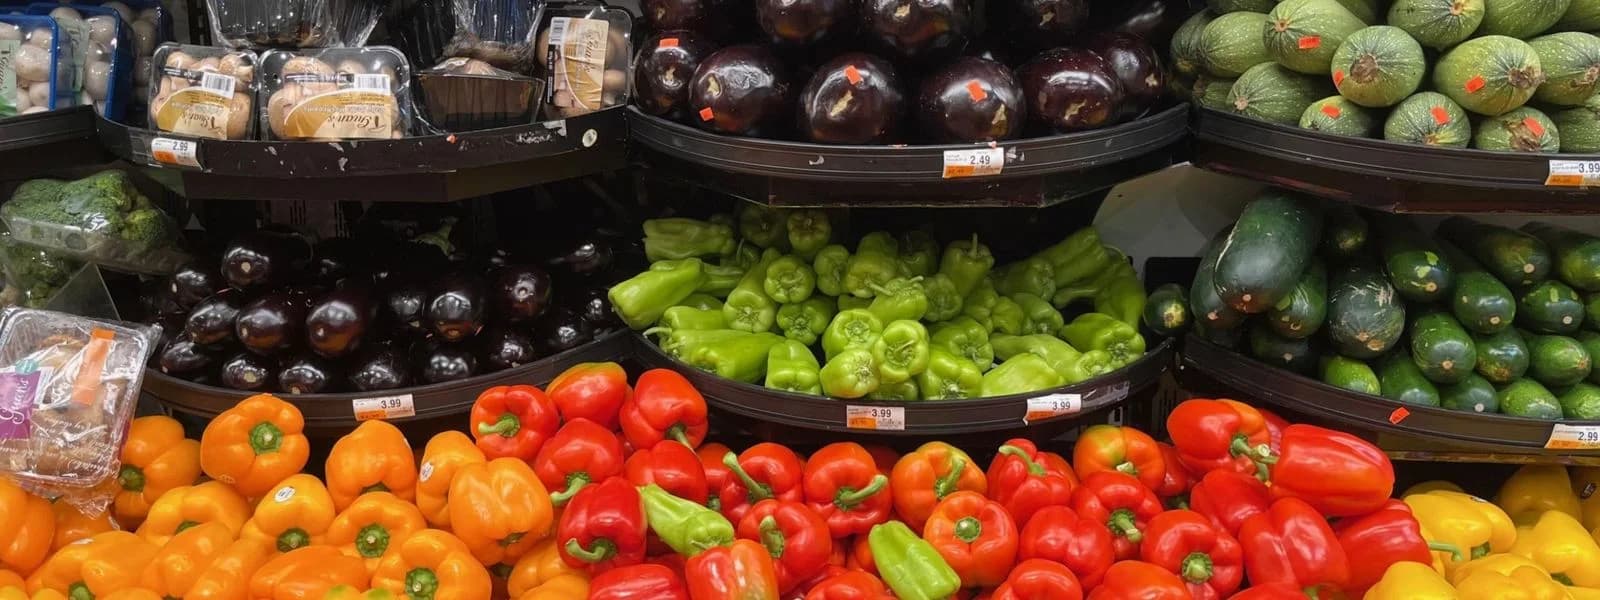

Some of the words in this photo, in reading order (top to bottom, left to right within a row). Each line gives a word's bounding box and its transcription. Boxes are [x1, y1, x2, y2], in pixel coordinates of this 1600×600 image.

[328, 114, 372, 129] Guan's
[172, 141, 188, 151] 2.99
[970, 155, 991, 165] 2.49
[1578, 162, 1600, 173] 3.99
[380, 399, 401, 409] 3.99
[1052, 401, 1071, 410] 3.99
[871, 408, 892, 418] 3.99
[1578, 431, 1599, 441] 2.99
